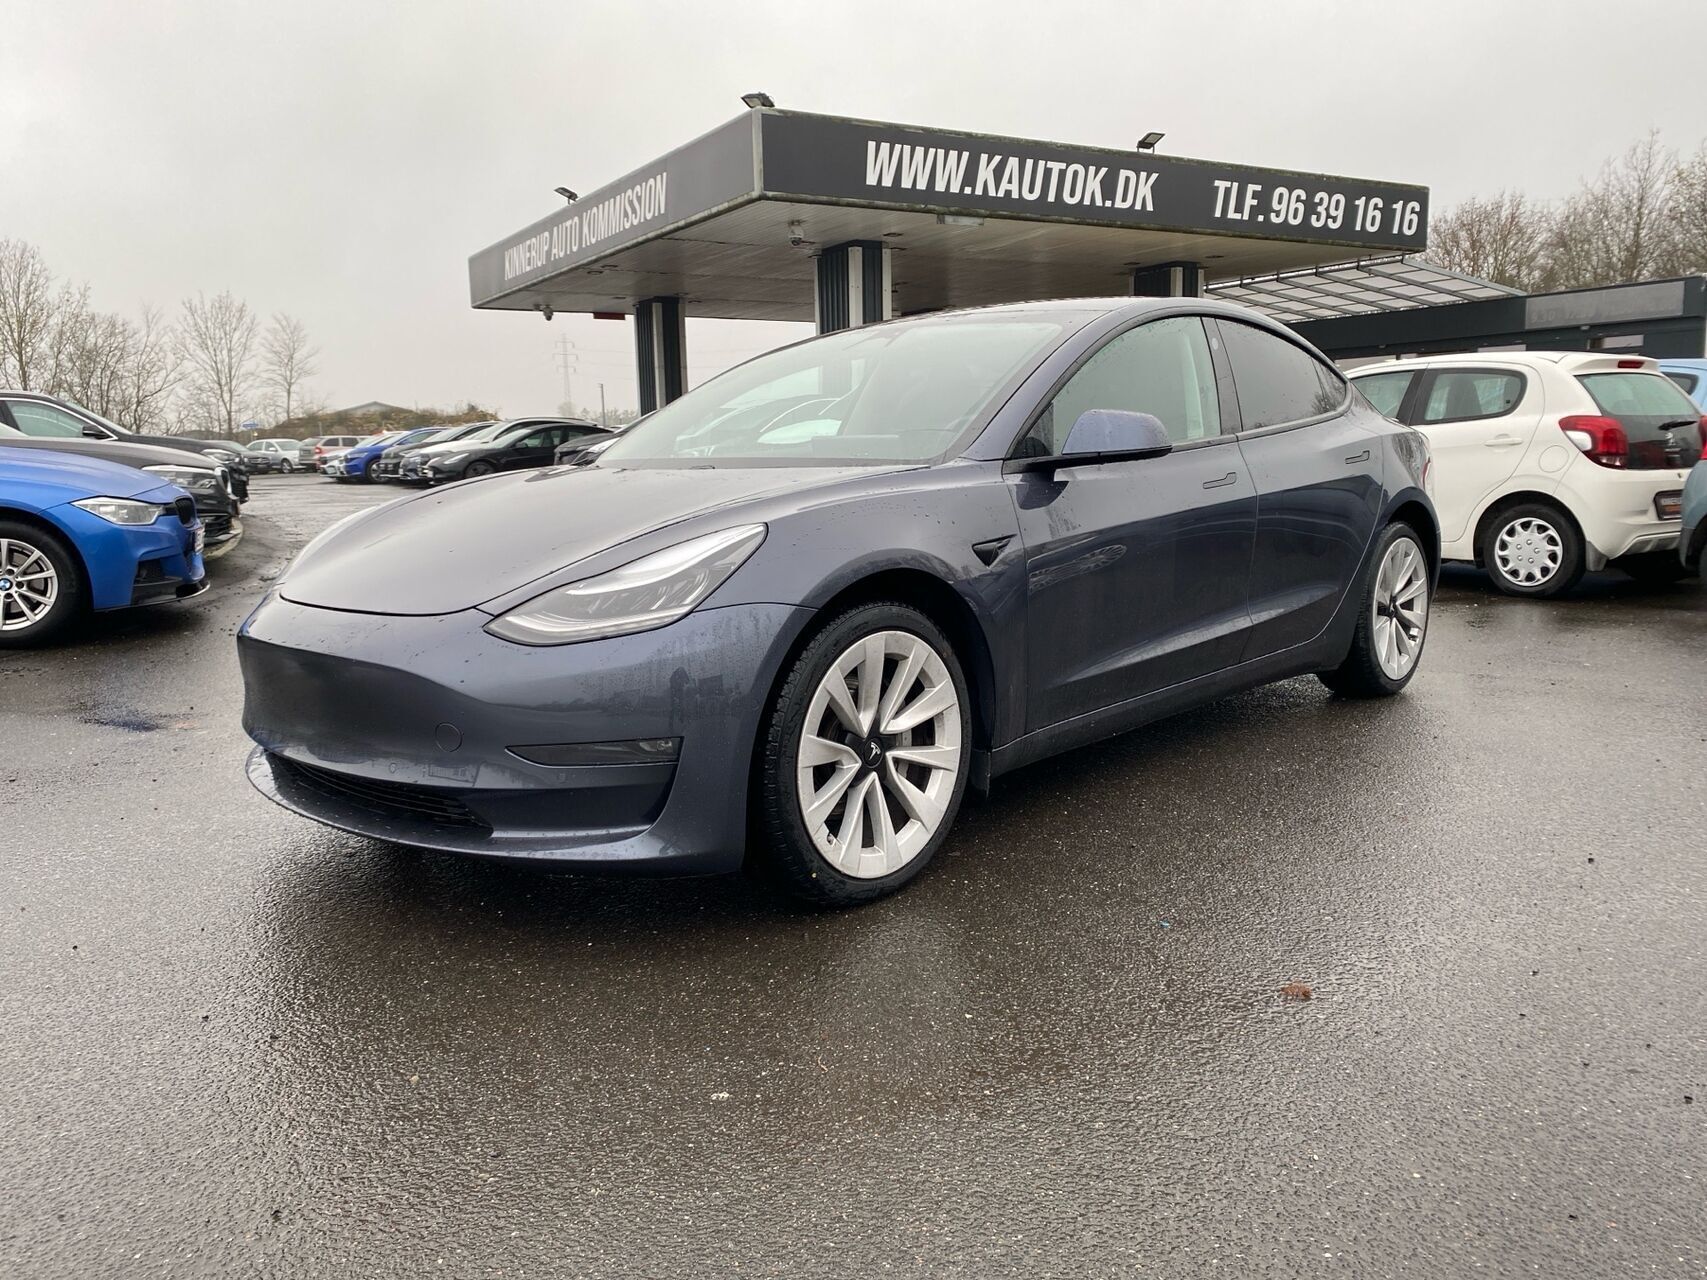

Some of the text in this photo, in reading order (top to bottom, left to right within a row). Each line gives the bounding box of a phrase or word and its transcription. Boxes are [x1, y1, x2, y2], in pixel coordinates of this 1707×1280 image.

[865, 140, 1160, 212] WWW.KAUTOK.DK
[1214, 179, 1421, 236] TLF. 96 39 16 16
[504, 172, 668, 281] KINNERUP AUTO KOMMISSION
